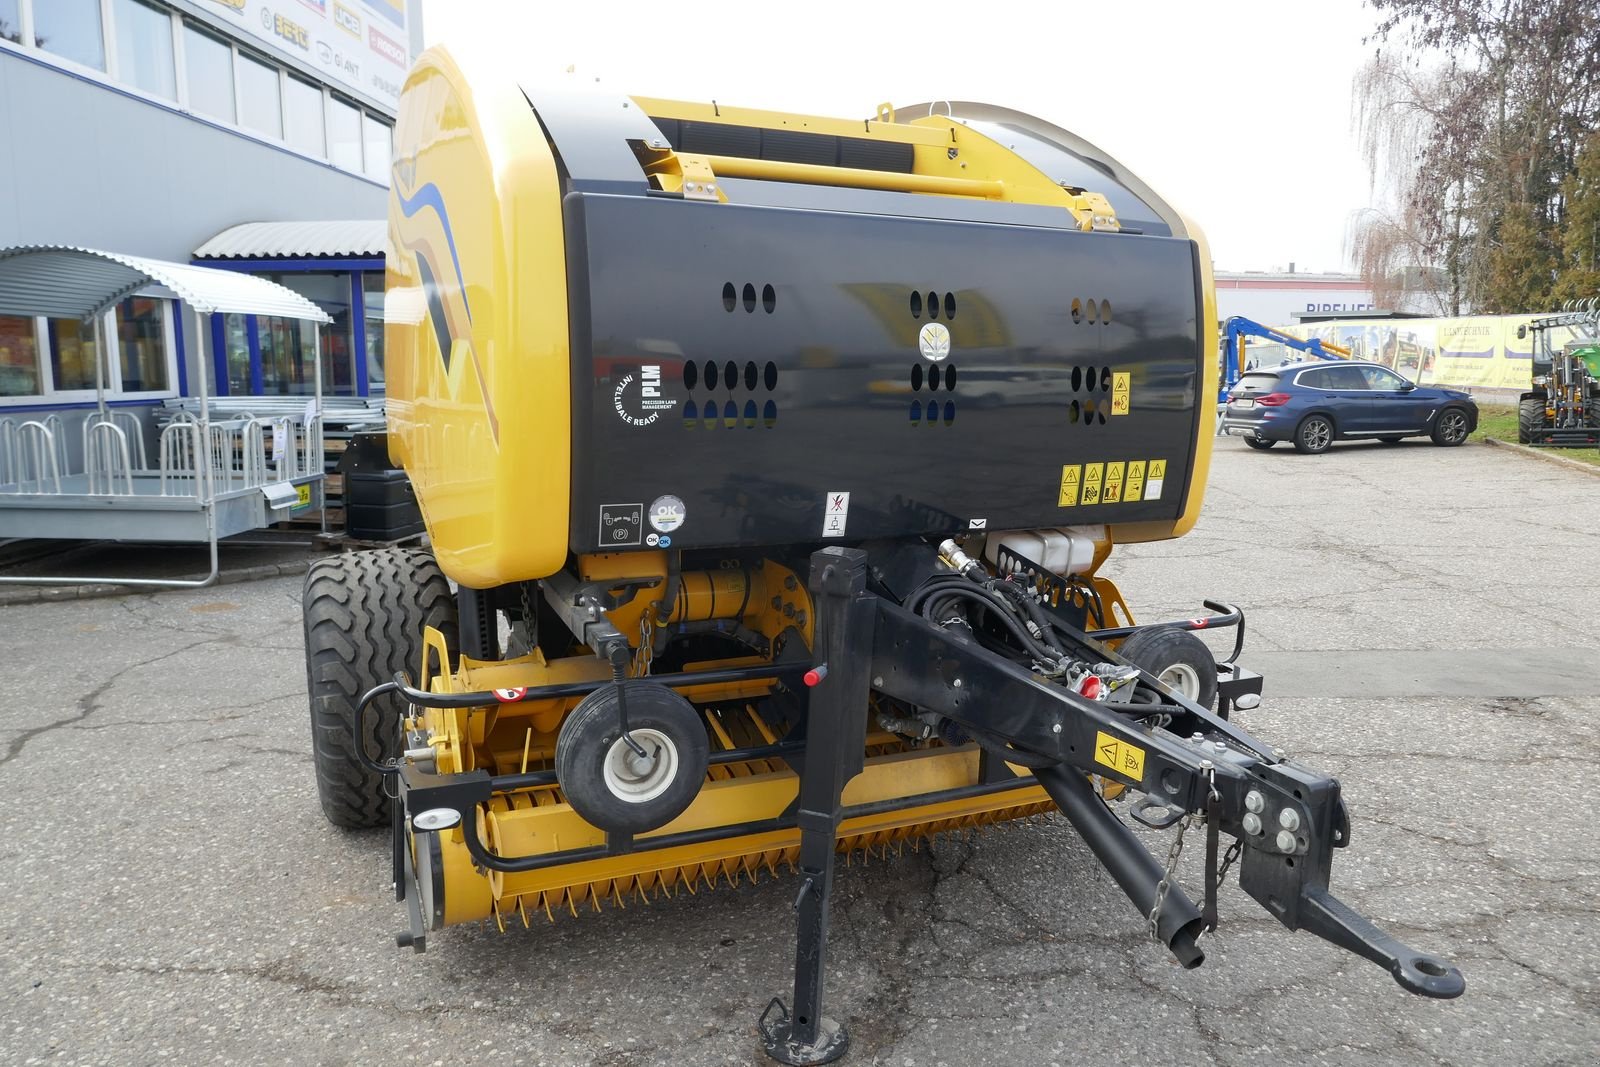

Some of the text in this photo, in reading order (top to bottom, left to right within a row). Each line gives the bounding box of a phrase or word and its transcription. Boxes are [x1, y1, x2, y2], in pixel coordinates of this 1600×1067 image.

[335, 7, 360, 36] JCB
[641, 365, 661, 397] PLM
[633, 411, 659, 426] READY
[657, 505, 678, 515] OK
